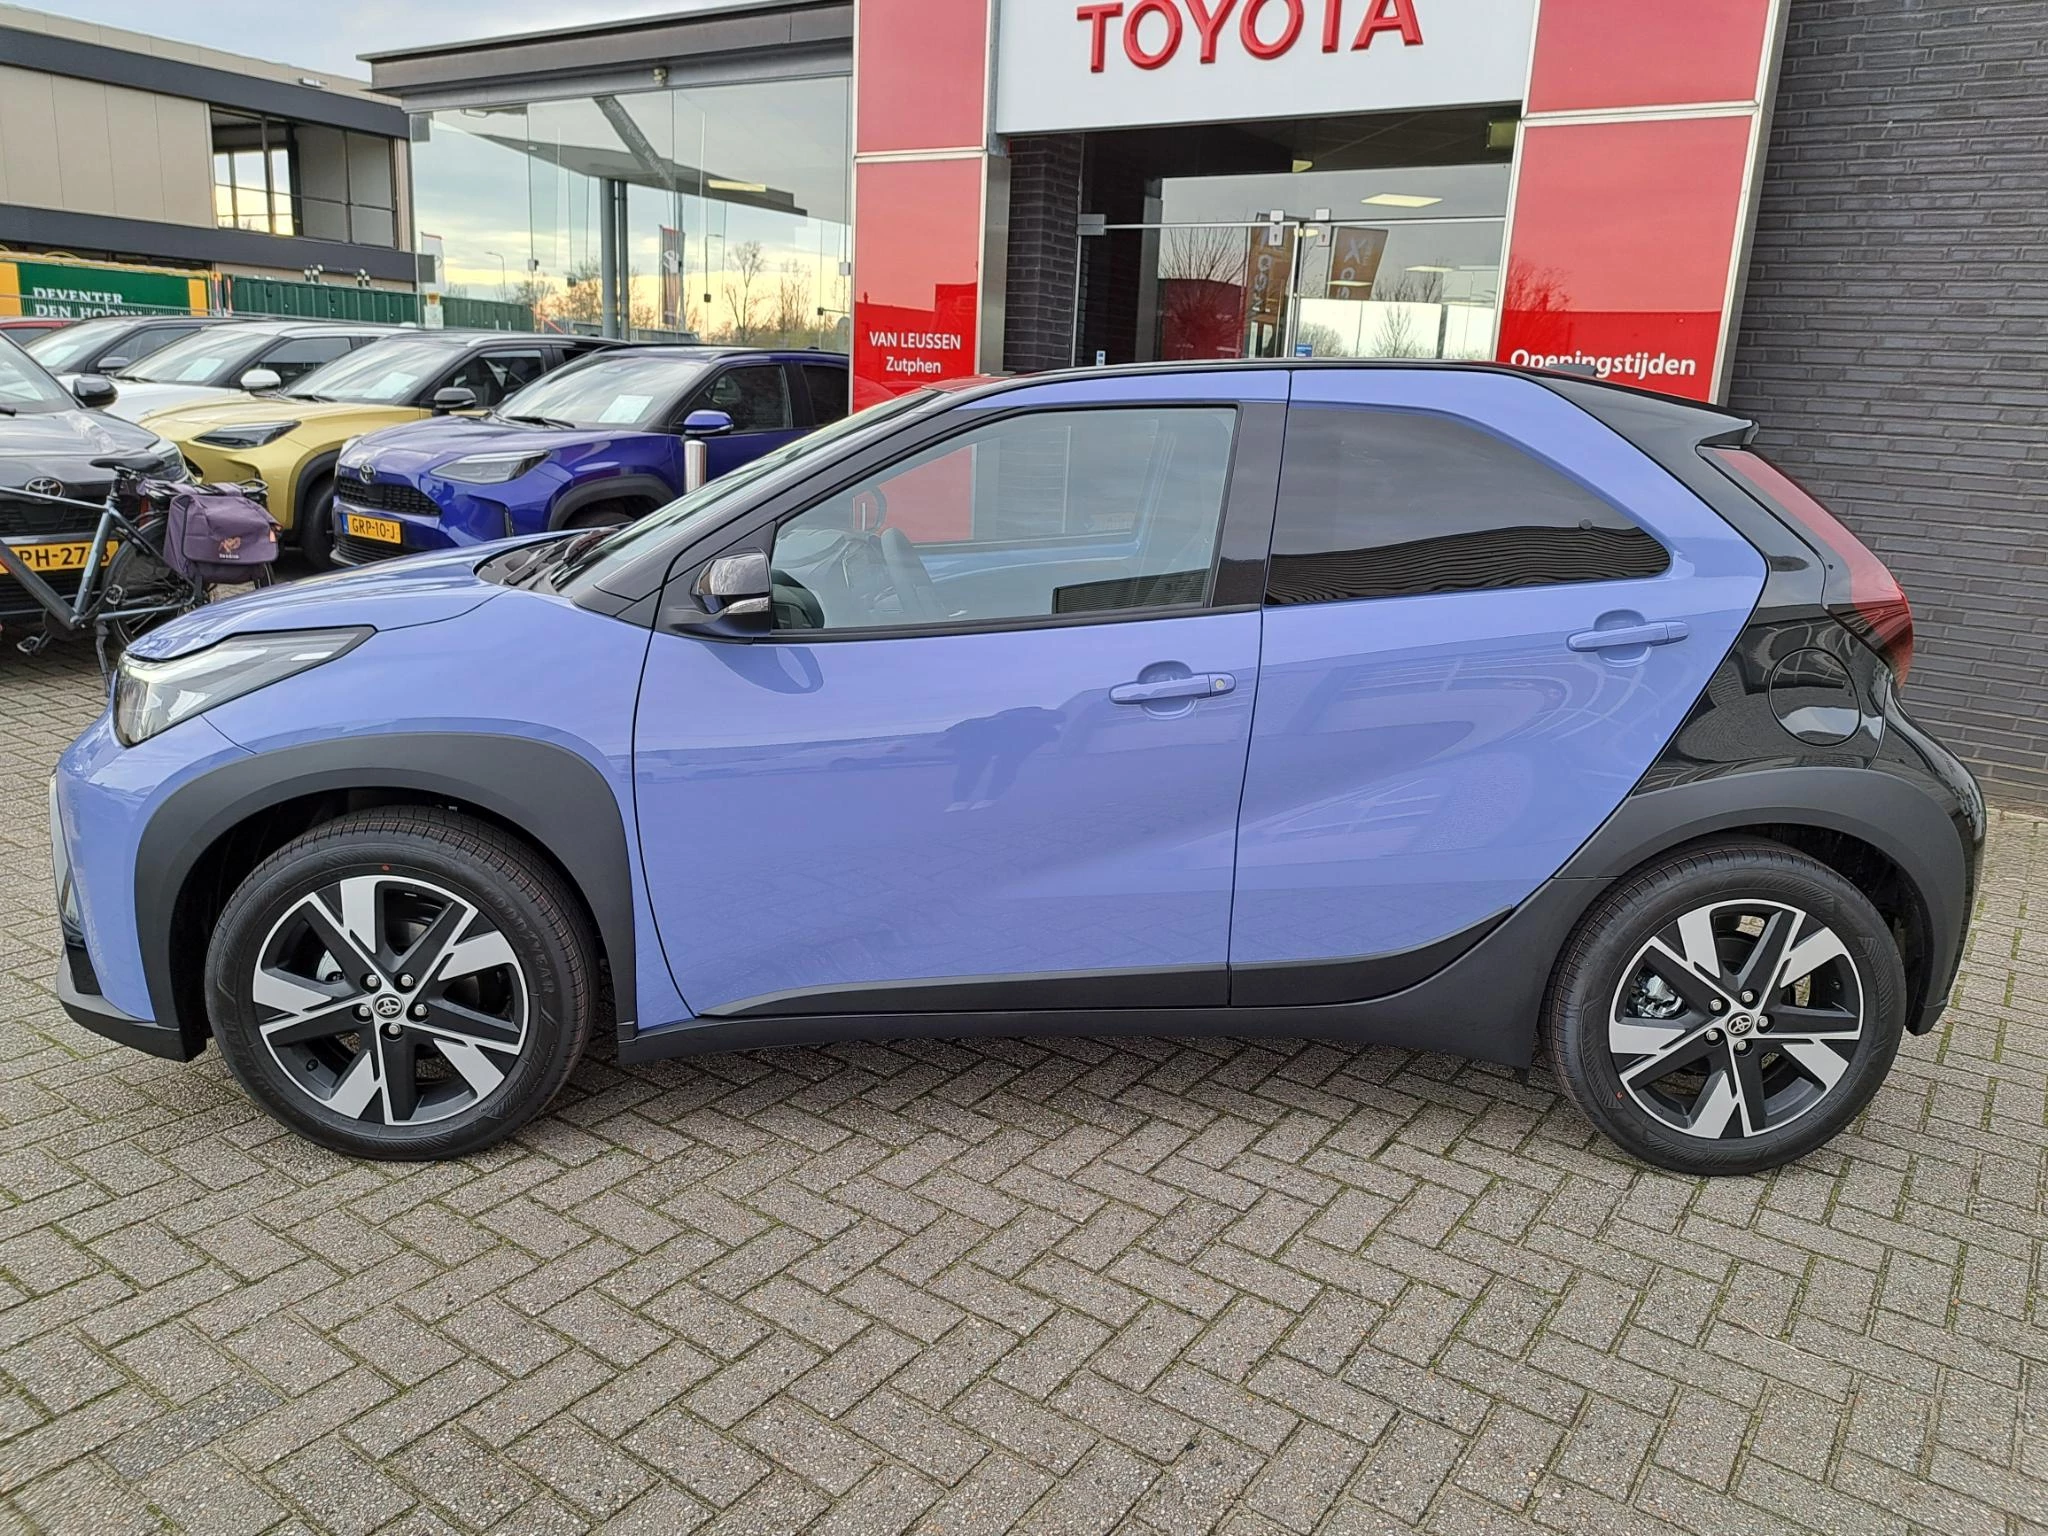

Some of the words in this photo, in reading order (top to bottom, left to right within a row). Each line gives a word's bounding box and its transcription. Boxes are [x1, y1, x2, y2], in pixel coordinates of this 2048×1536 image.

[1077, 0, 1424, 73] TOYOTA
[32, 286, 123, 304] DEVENTER
[35, 303, 71, 318] DEN
[869, 331, 897, 347] VAN
[901, 332, 961, 350] LEUSSEN
[886, 356, 941, 376] Zutphen
[1510, 349, 1696, 380] Openingstijden
[352, 518, 396, 539] GRP-10-J
